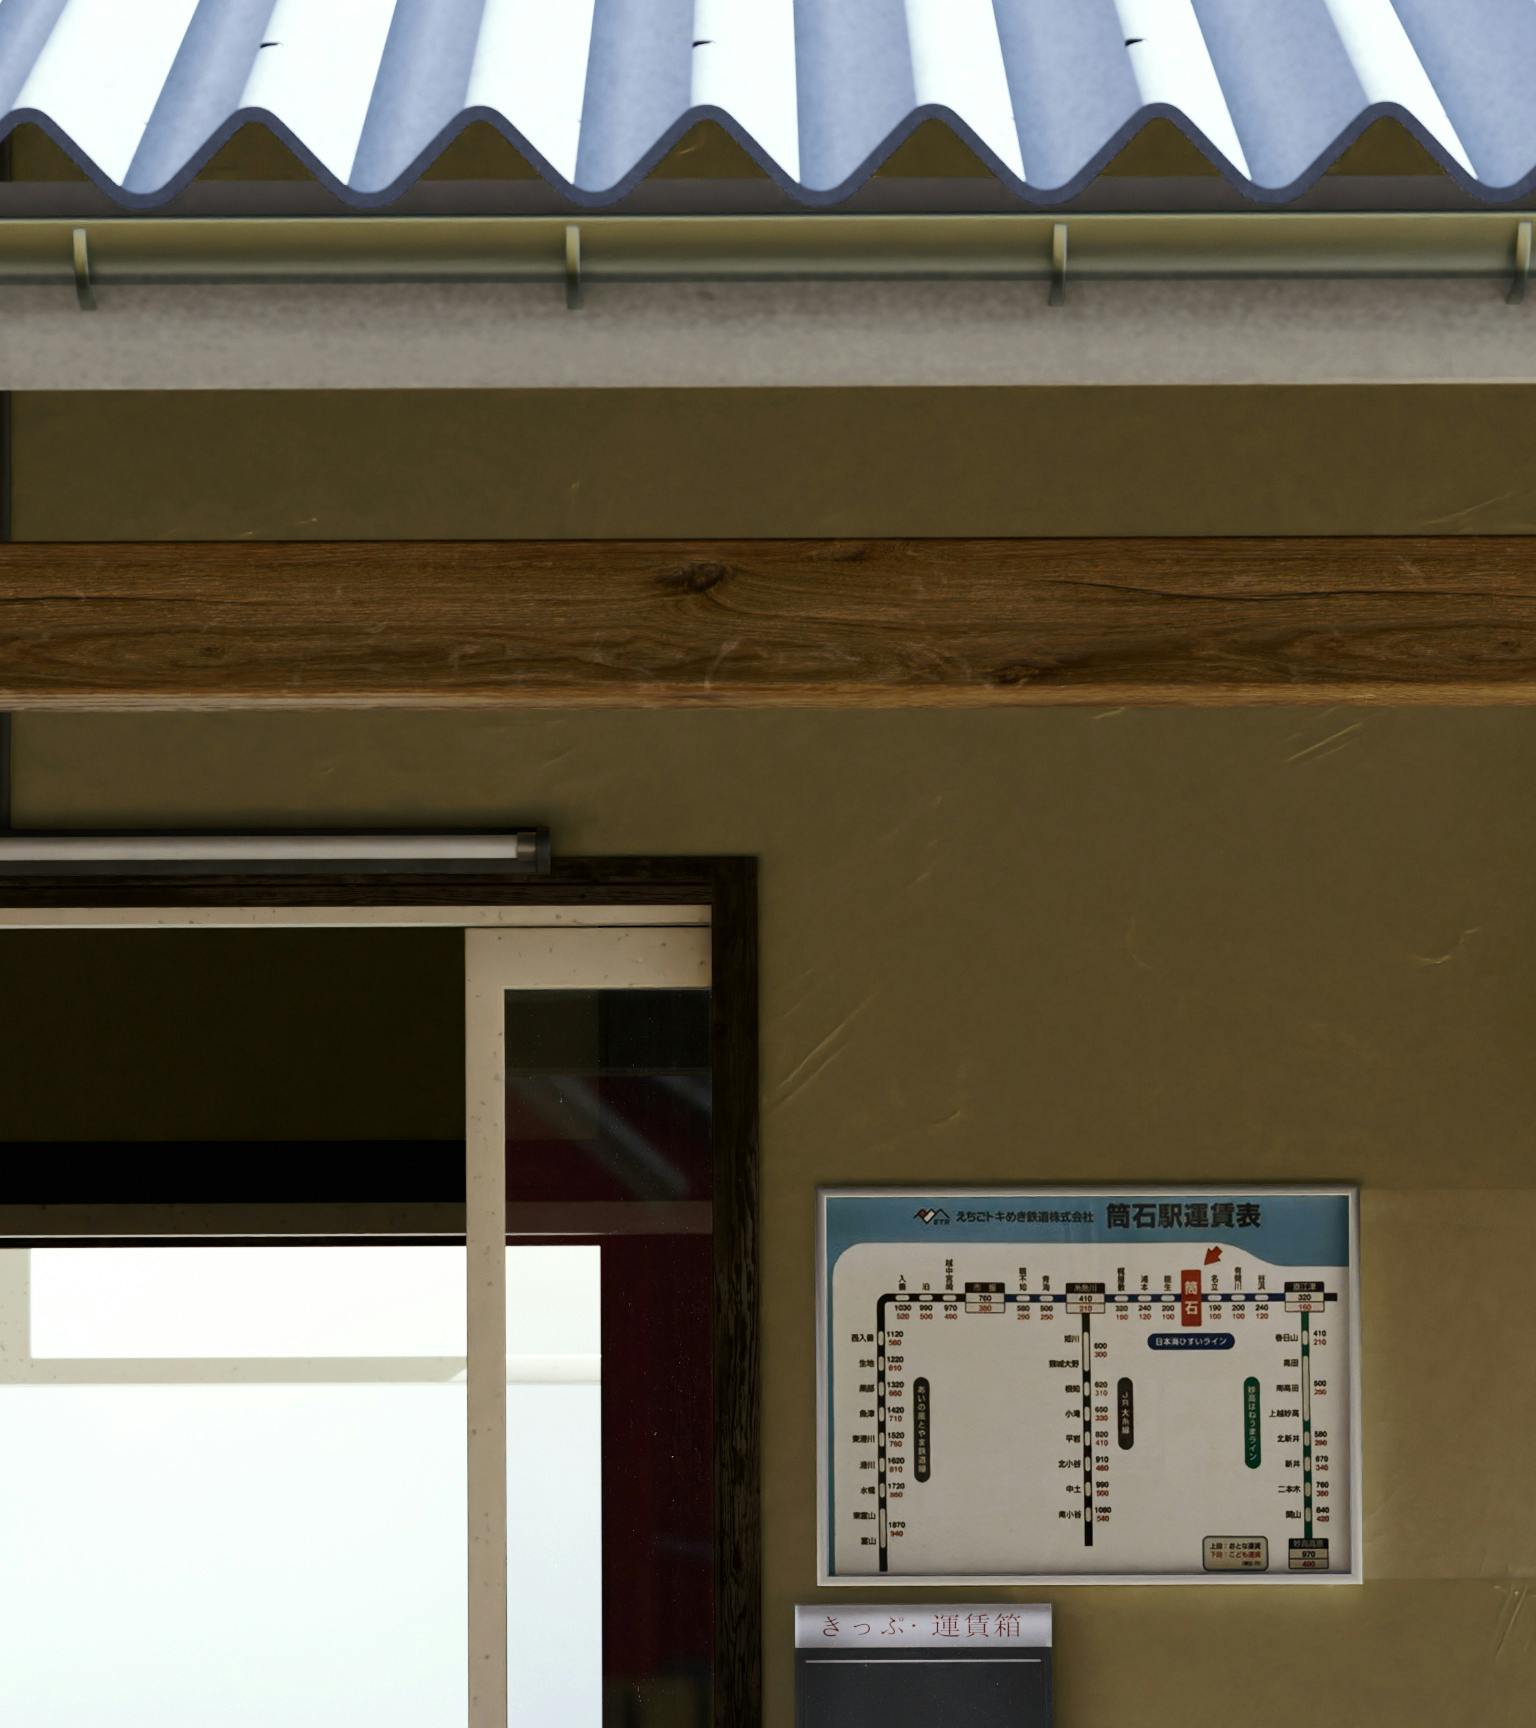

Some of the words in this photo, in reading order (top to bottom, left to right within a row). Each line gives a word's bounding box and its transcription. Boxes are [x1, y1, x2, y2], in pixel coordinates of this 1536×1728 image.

[956, 1211, 1094, 1223] えちごトキめき鉄道株式会社
[1106, 1203, 1262, 1229] 筒石駅運賃表
[1231, 1304, 1245, 1312] 200
[887, 1330, 904, 1338] 1120
[888, 1482, 906, 1490] 1720
[820, 1611, 1023, 1640] きっぷ・運賃箱
